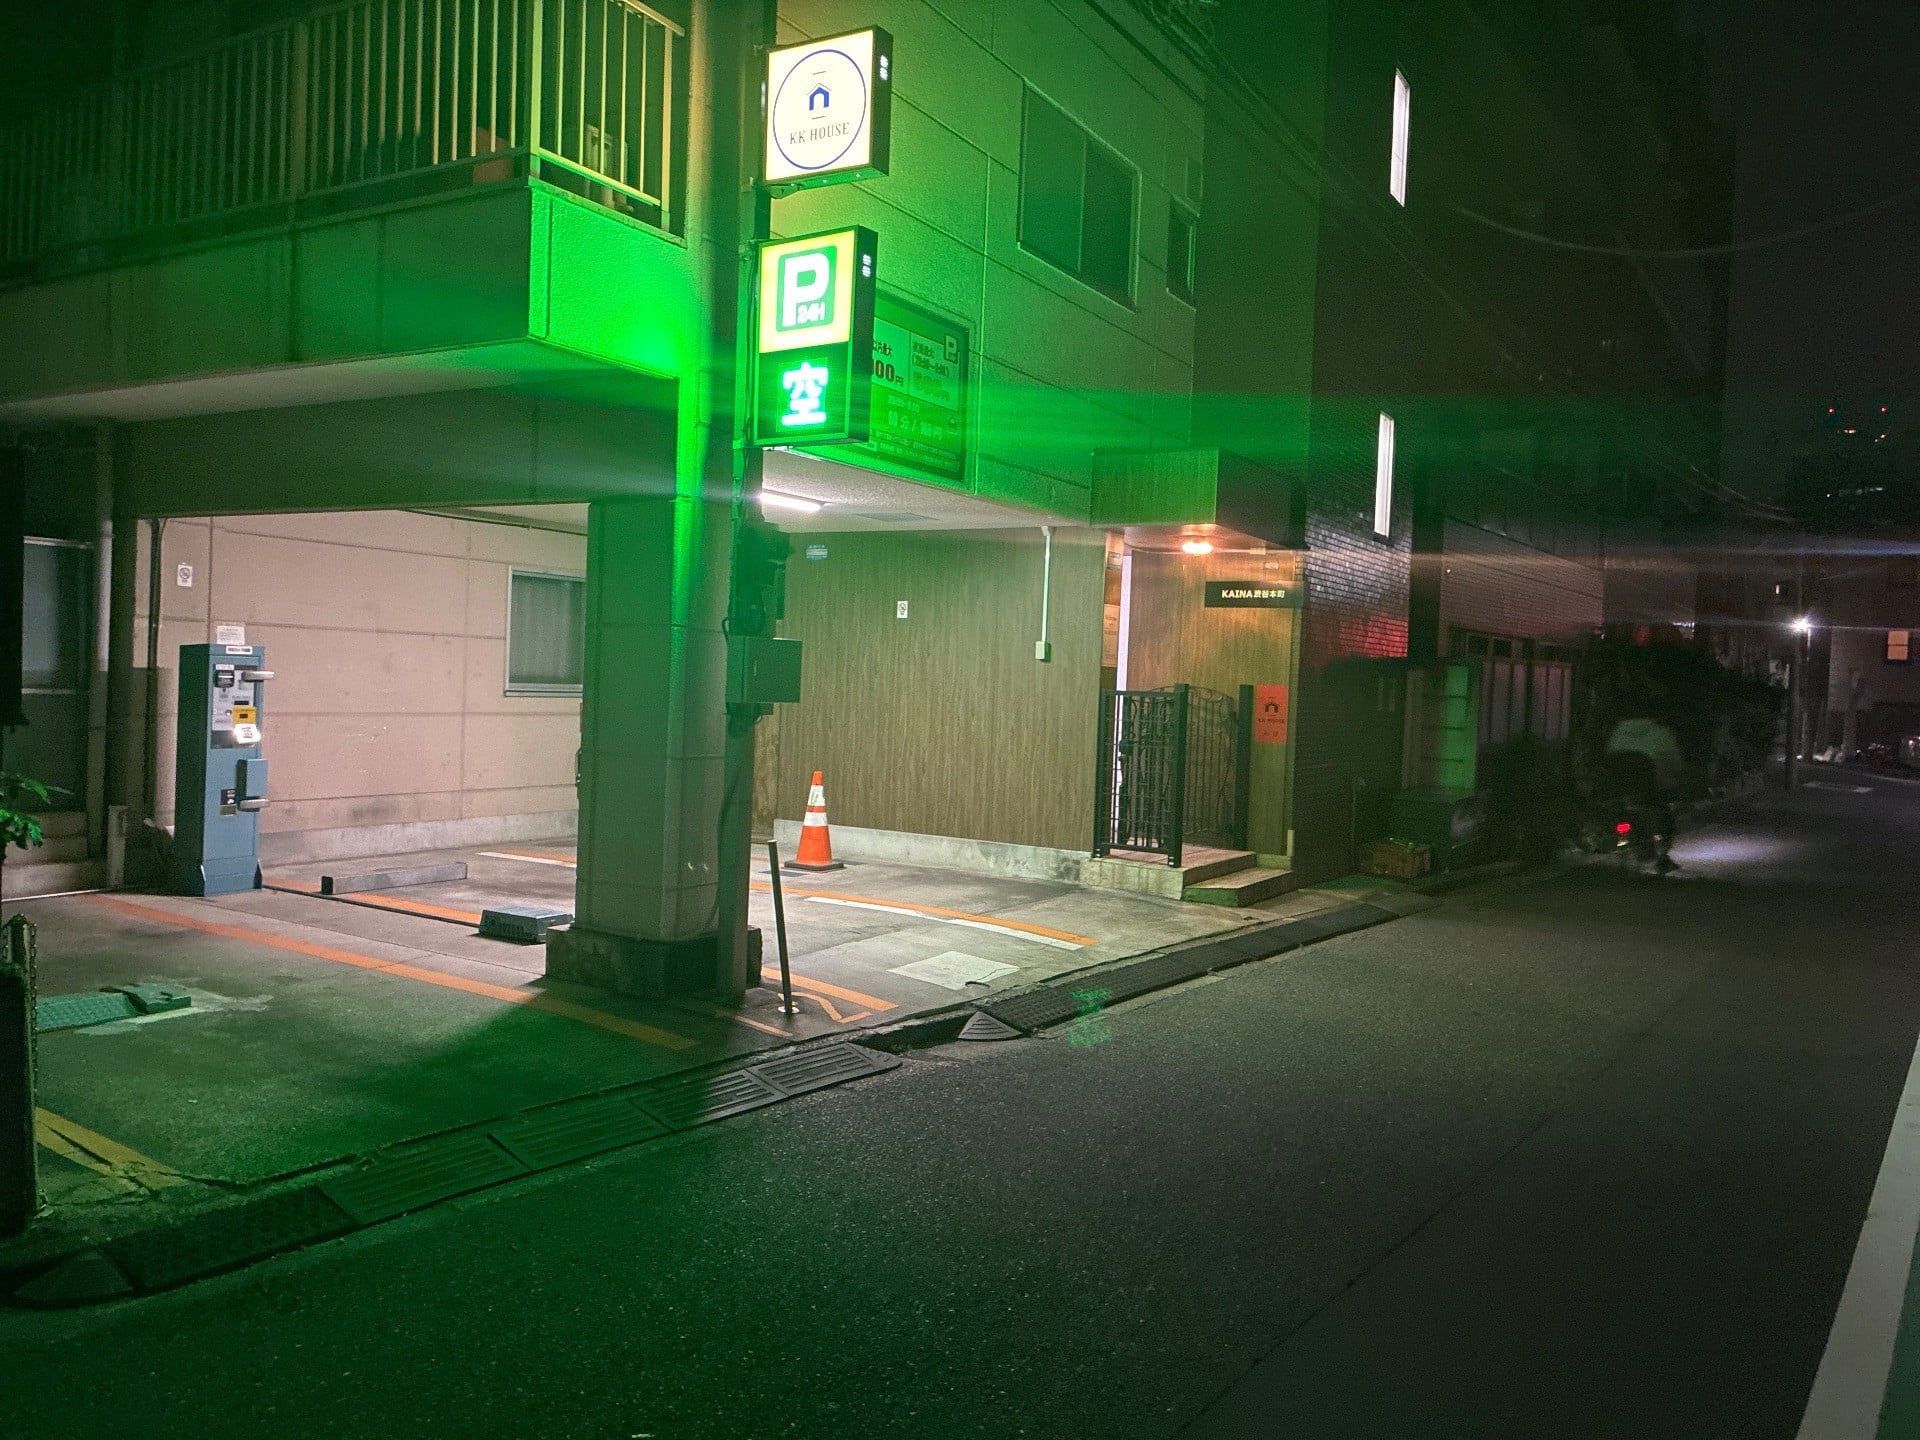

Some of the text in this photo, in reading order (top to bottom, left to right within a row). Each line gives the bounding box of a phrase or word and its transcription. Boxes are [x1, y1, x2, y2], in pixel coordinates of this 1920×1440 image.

[789, 122, 850, 145] KK HOUSE
[781, 252, 831, 327] P
[782, 362, 830, 426] 空
